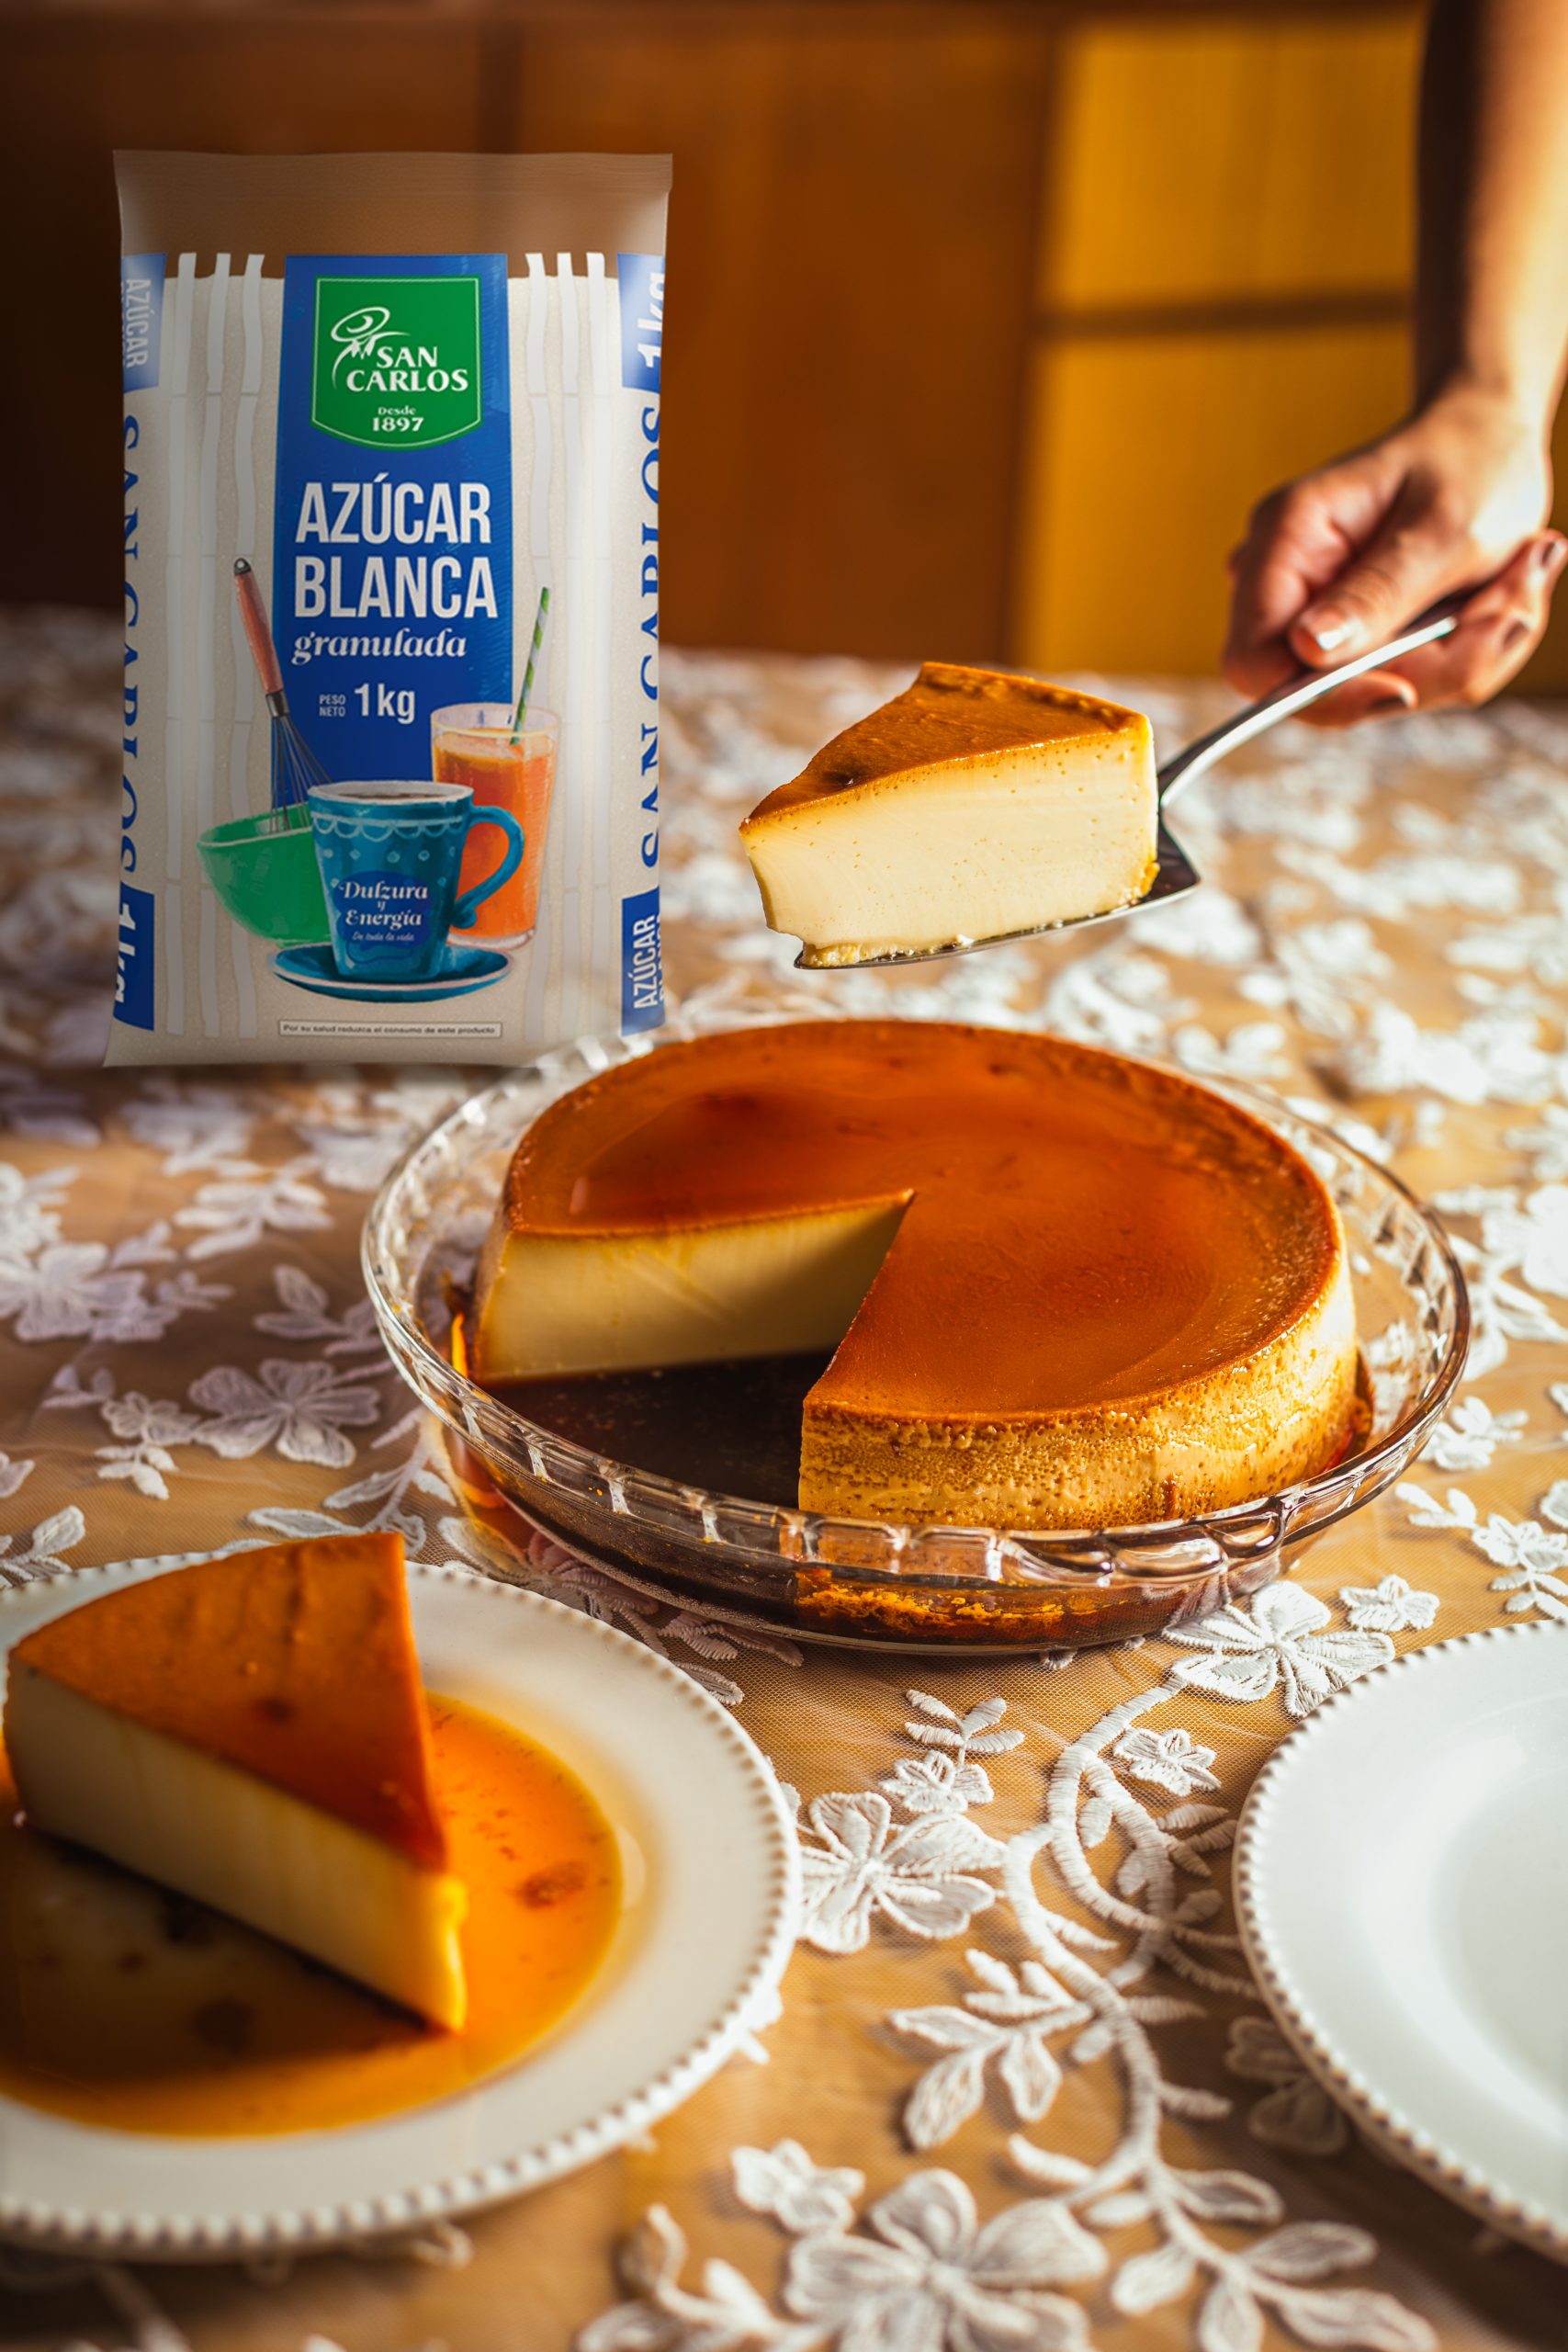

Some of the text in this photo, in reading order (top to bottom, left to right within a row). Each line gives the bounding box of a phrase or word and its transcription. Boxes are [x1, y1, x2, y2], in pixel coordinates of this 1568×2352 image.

[126, 278, 155, 368] AZÚCAR
[377, 346, 438, 368] SAN
[346, 368, 468, 392] CARLOS
[378, 405, 416, 415] Desde
[372, 417, 424, 432] 1897
[295, 472, 491, 544] AZÚCAR
[295, 556, 498, 618] BLANCA
[291, 628, 468, 665] granulada
[319, 695, 345, 705] PESO
[319, 707, 345, 718] NETO
[338, 880, 428, 899] Dulzura
[378, 901, 386, 911] y
[345, 909, 423, 930] Energía
[627, 914, 659, 1009] AZÚCAR
[283, 1023, 299, 1032] Por
[313, 1024, 335, 1033] salud
